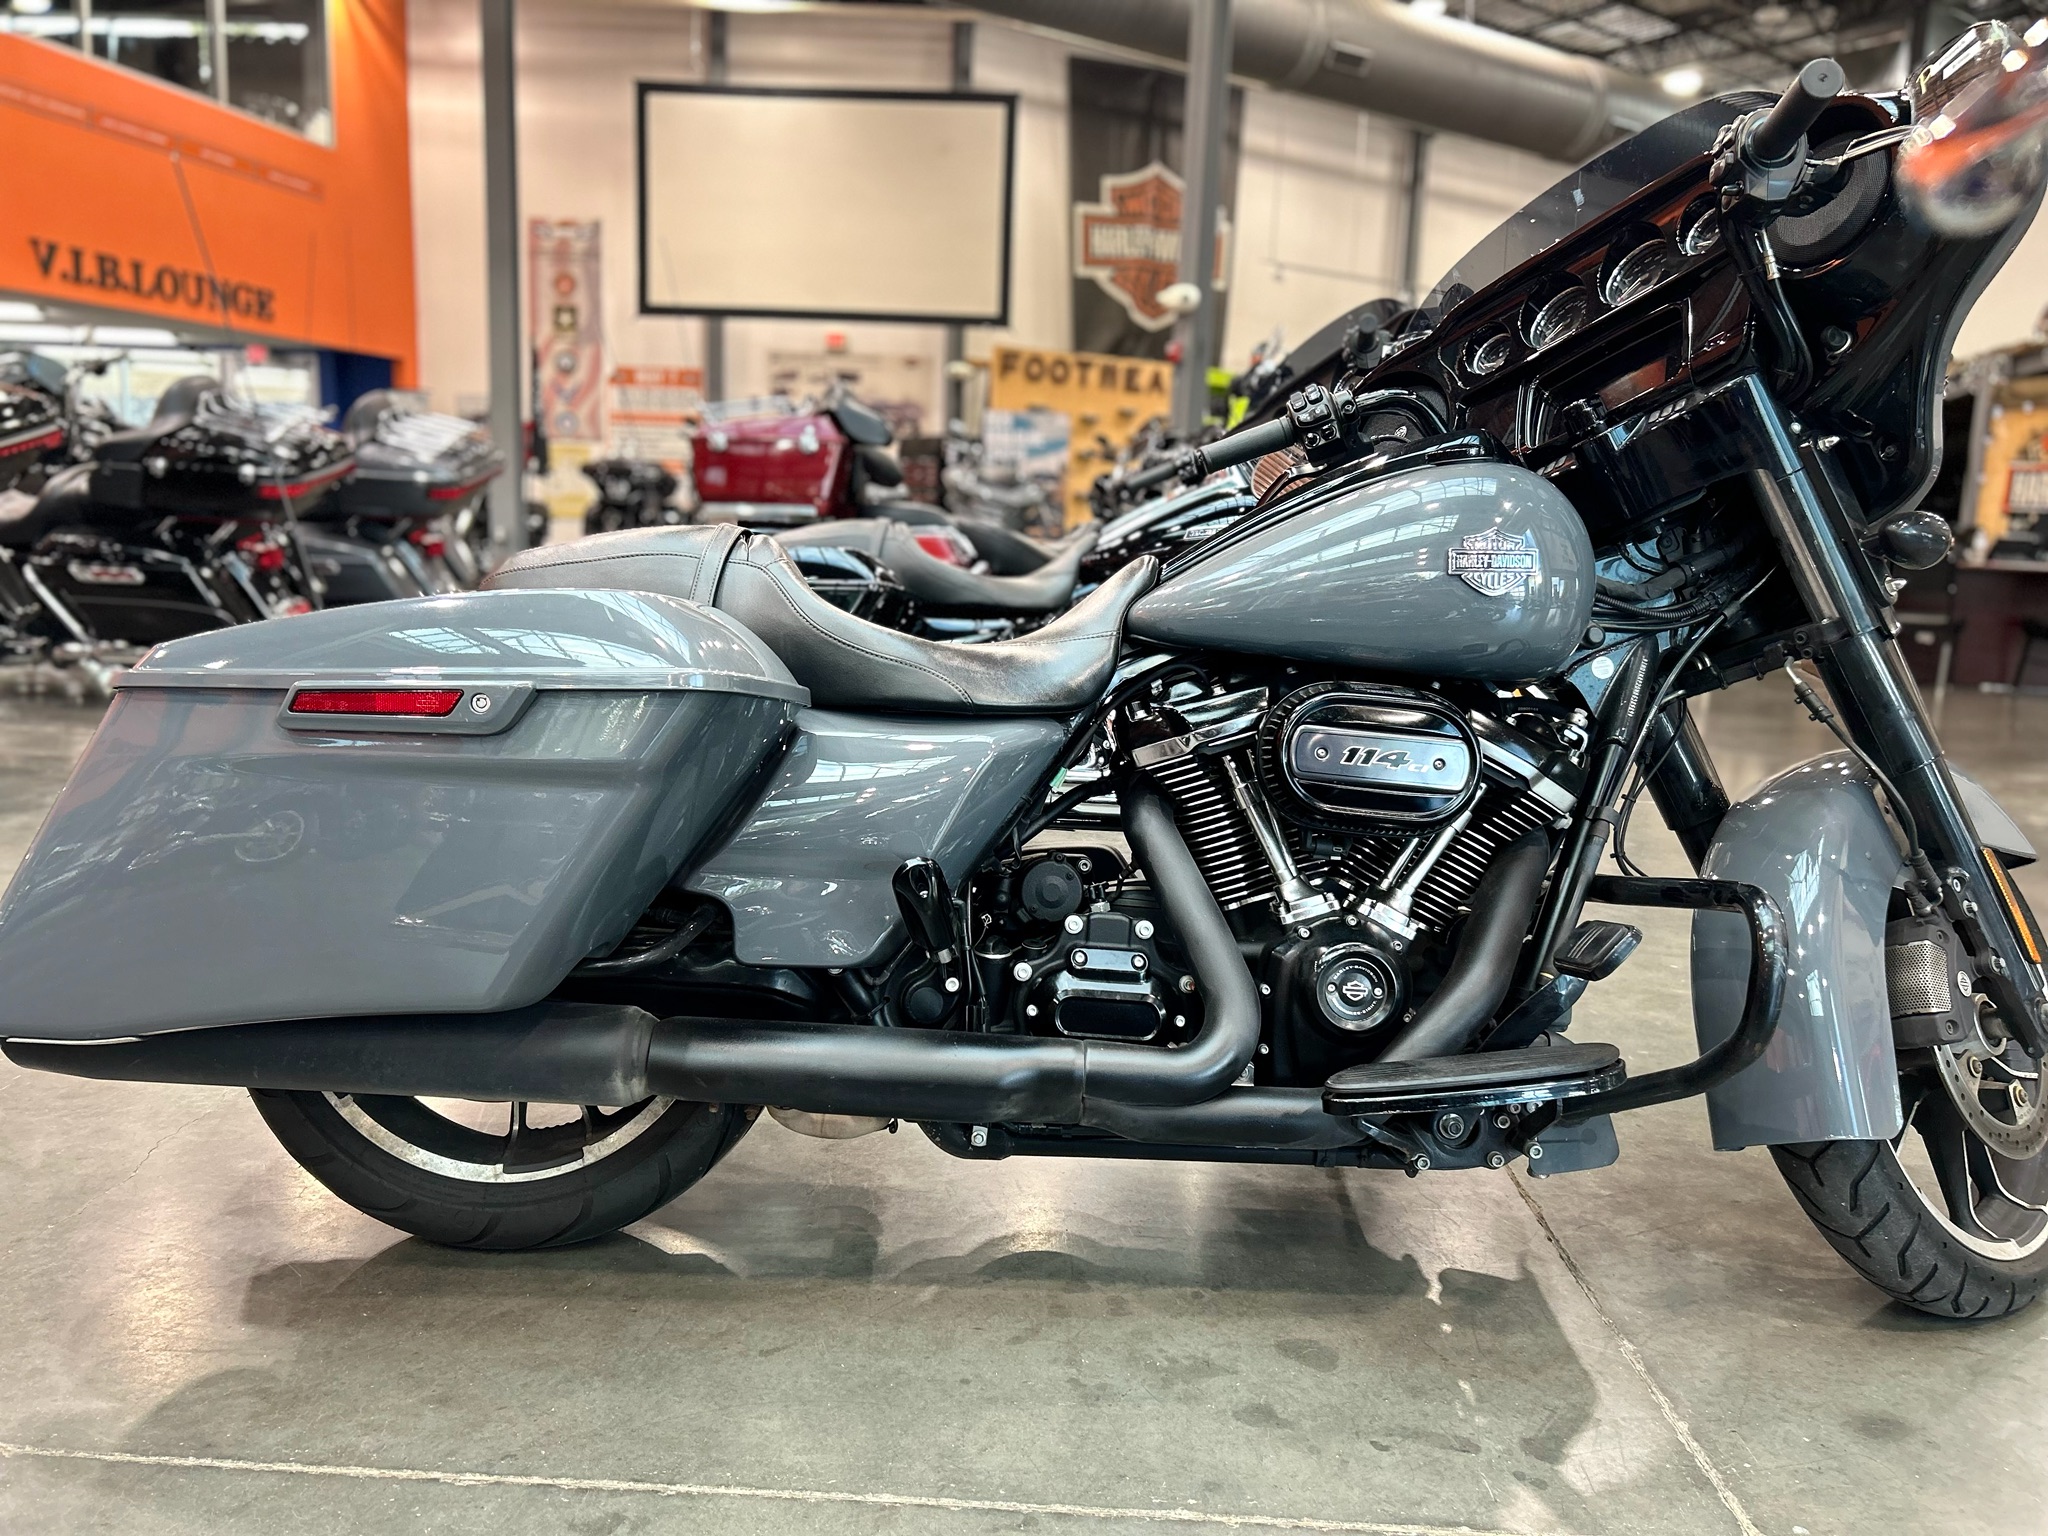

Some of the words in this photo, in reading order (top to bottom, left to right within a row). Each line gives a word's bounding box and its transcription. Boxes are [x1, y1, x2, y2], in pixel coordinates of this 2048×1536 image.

[1473, 536, 1517, 550] MOTOR
[1456, 553, 1533, 569] HARLEY-DAVIDSON
[1473, 572, 1516, 590] CYCLES
